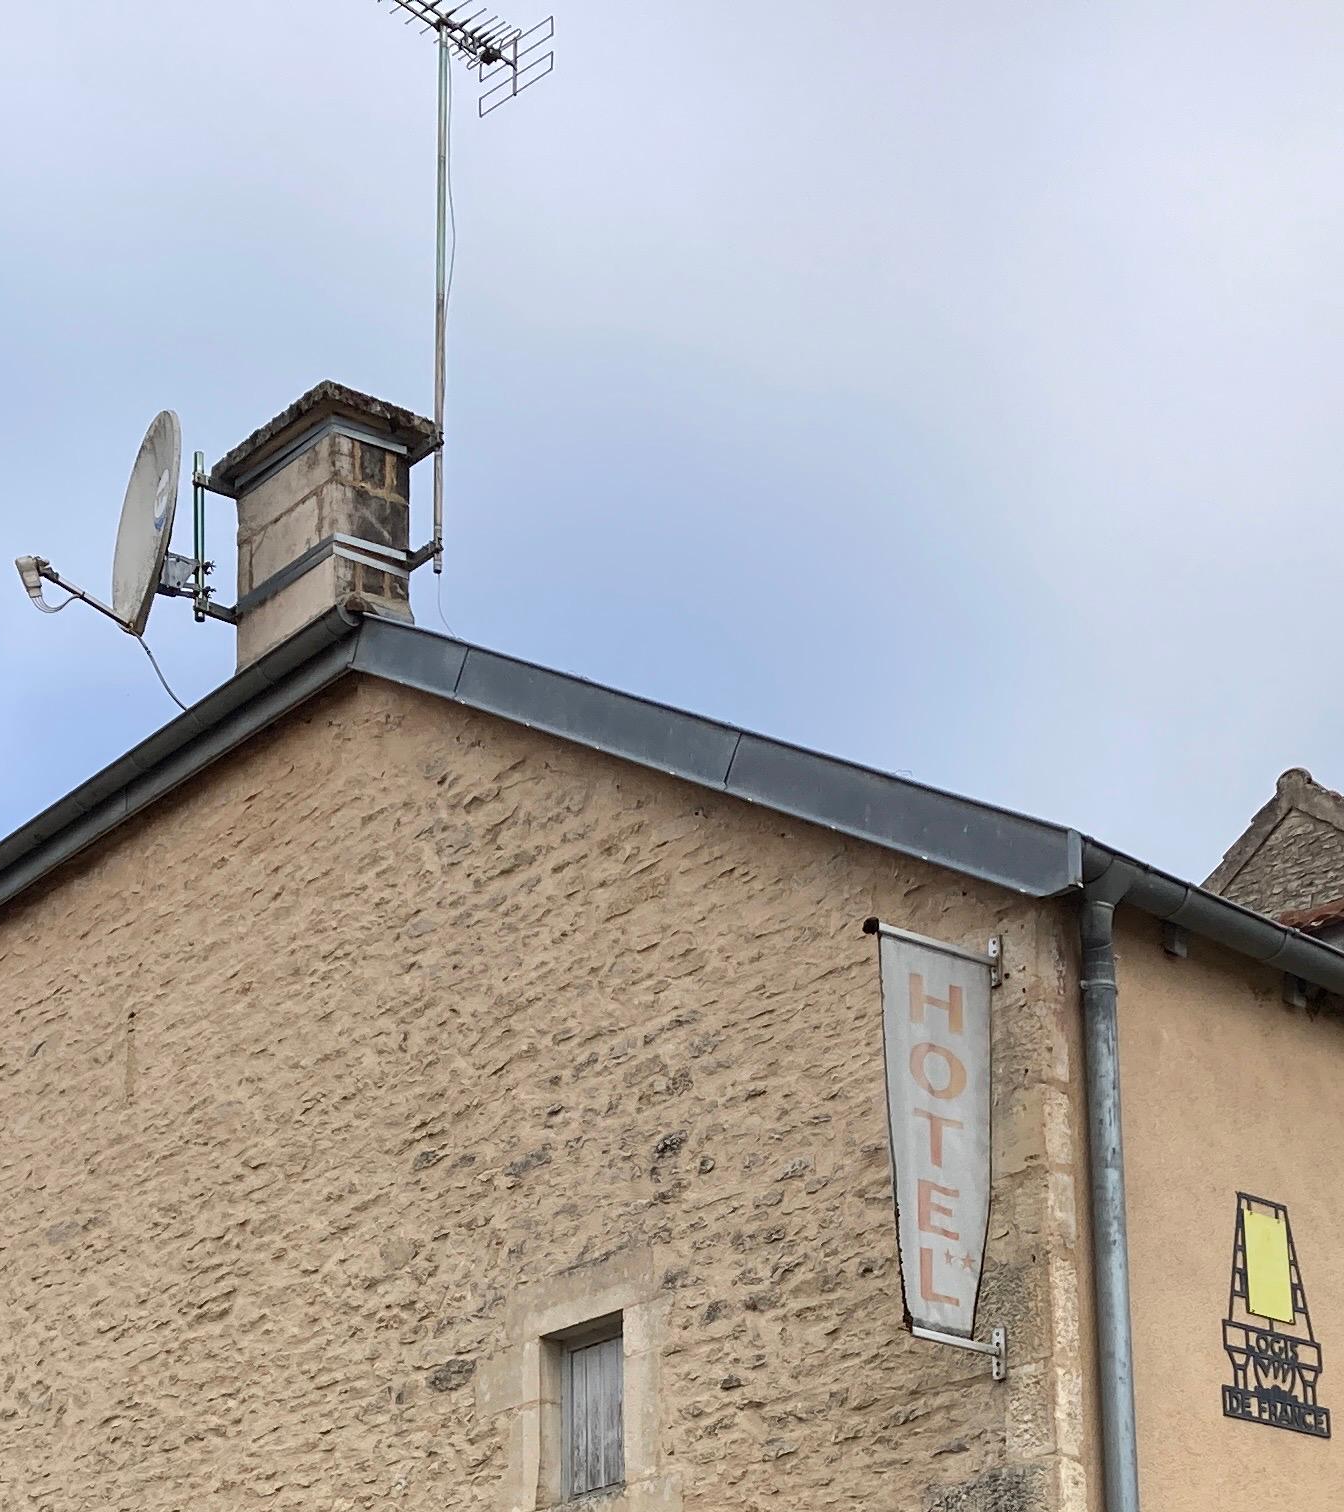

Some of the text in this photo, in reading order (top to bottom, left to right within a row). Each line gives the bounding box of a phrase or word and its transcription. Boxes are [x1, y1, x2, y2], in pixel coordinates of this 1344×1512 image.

[908, 972, 968, 1308] HOTEL
[1245, 1330, 1299, 1362] LOGIS
[1228, 1391, 1328, 1433] DE FRANCE
